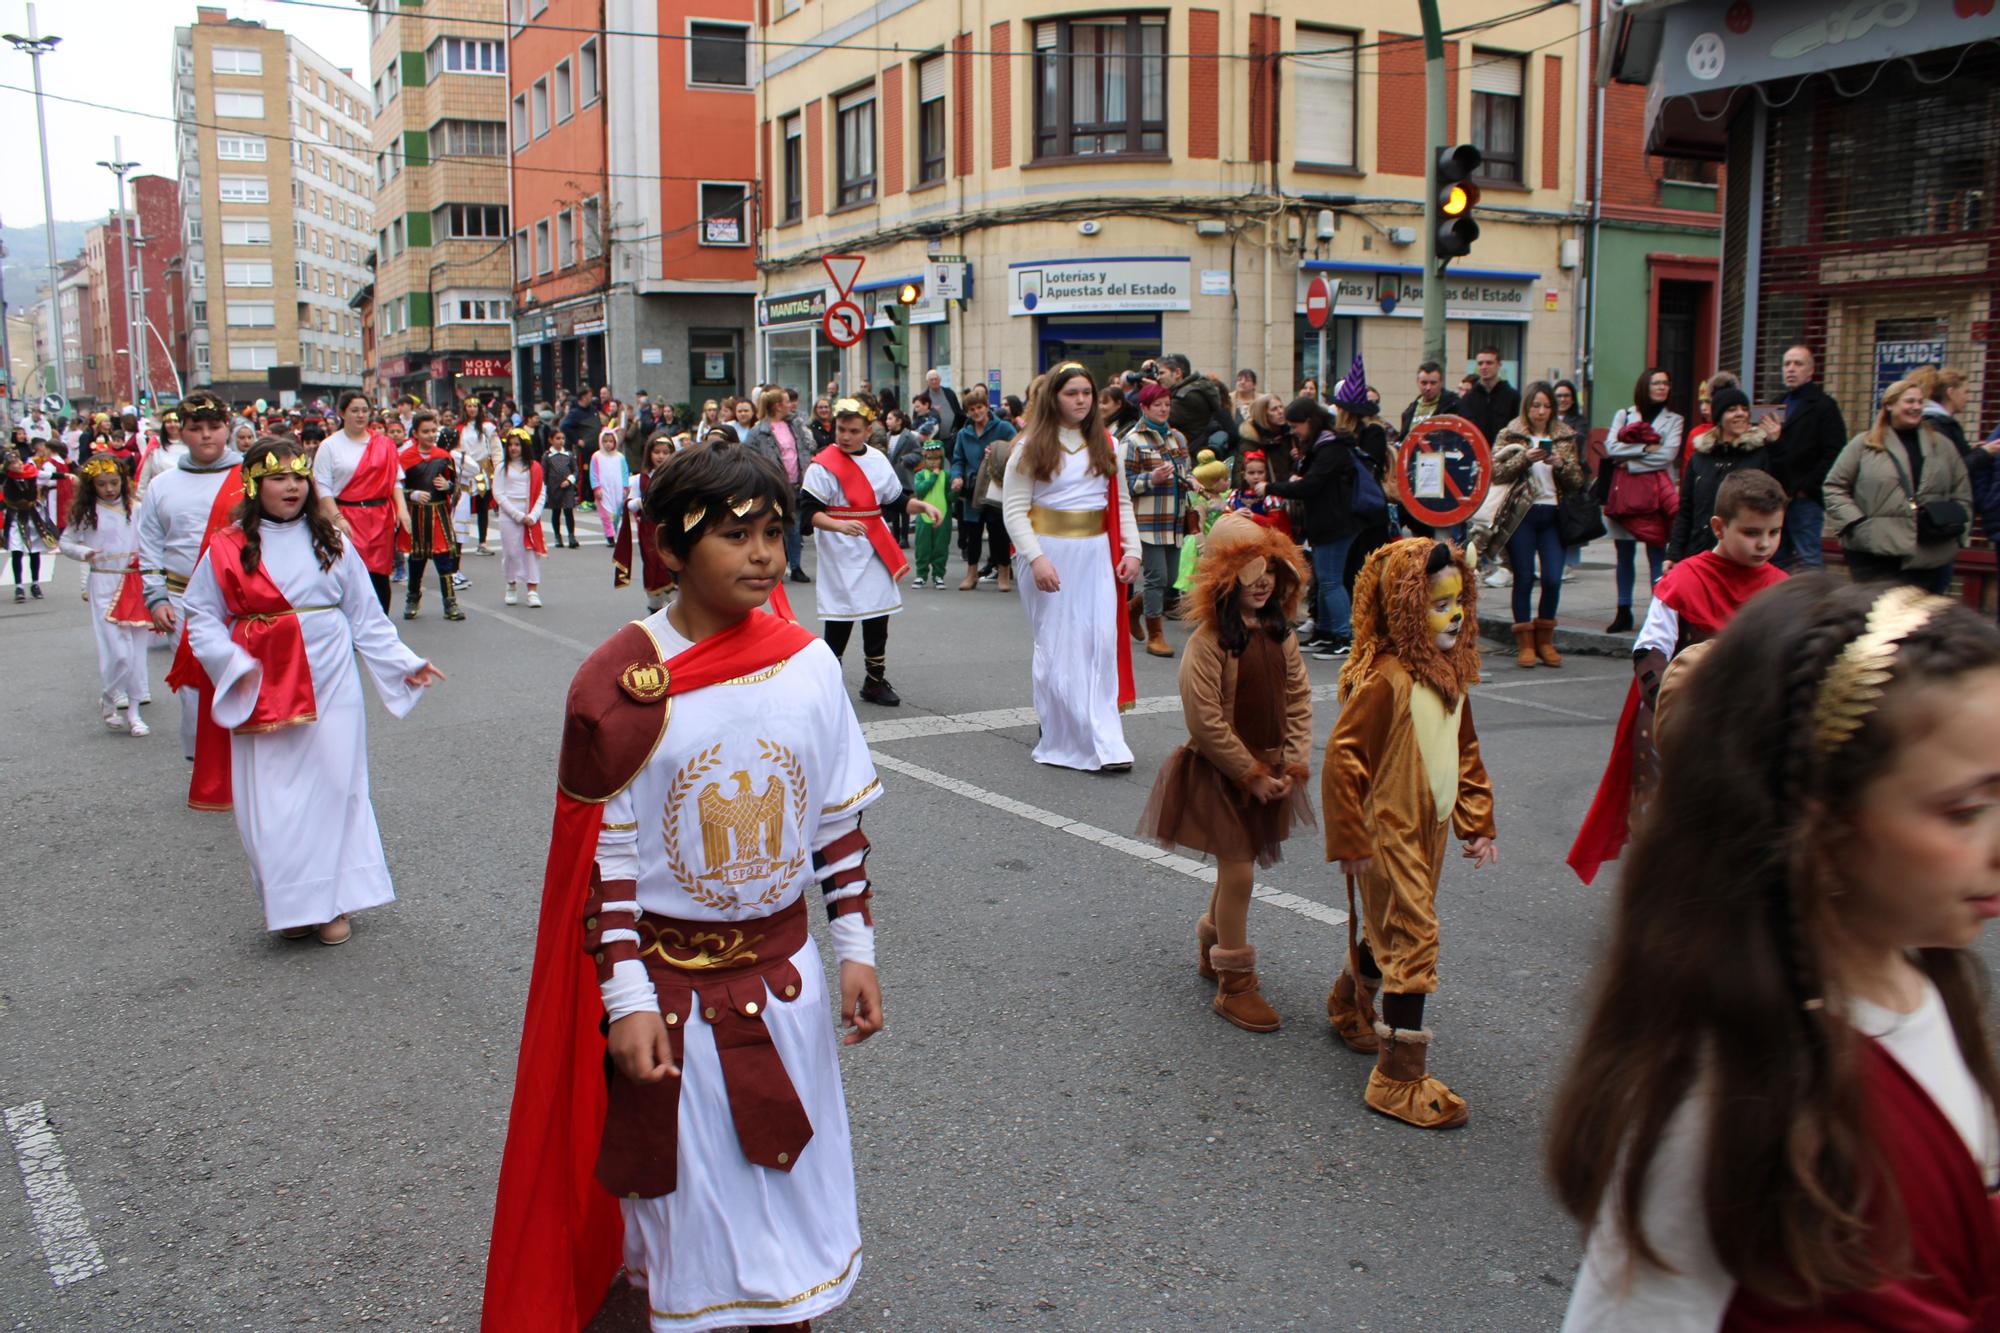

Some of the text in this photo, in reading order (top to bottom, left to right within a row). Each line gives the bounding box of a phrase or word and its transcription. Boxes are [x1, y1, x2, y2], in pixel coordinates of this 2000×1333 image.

[1099, 272, 1106, 284] y
[1047, 283, 1176, 299] Apuestas del Estado
[1366, 286, 1374, 300] y
[1461, 286, 1479, 300] del
[1482, 288, 1522, 302] Estado
[770, 300, 810, 318] MANITAS
[1881, 343, 1942, 364] VENDE
[465, 359, 502, 369] MODA
[732, 865, 764, 880] SPQR
